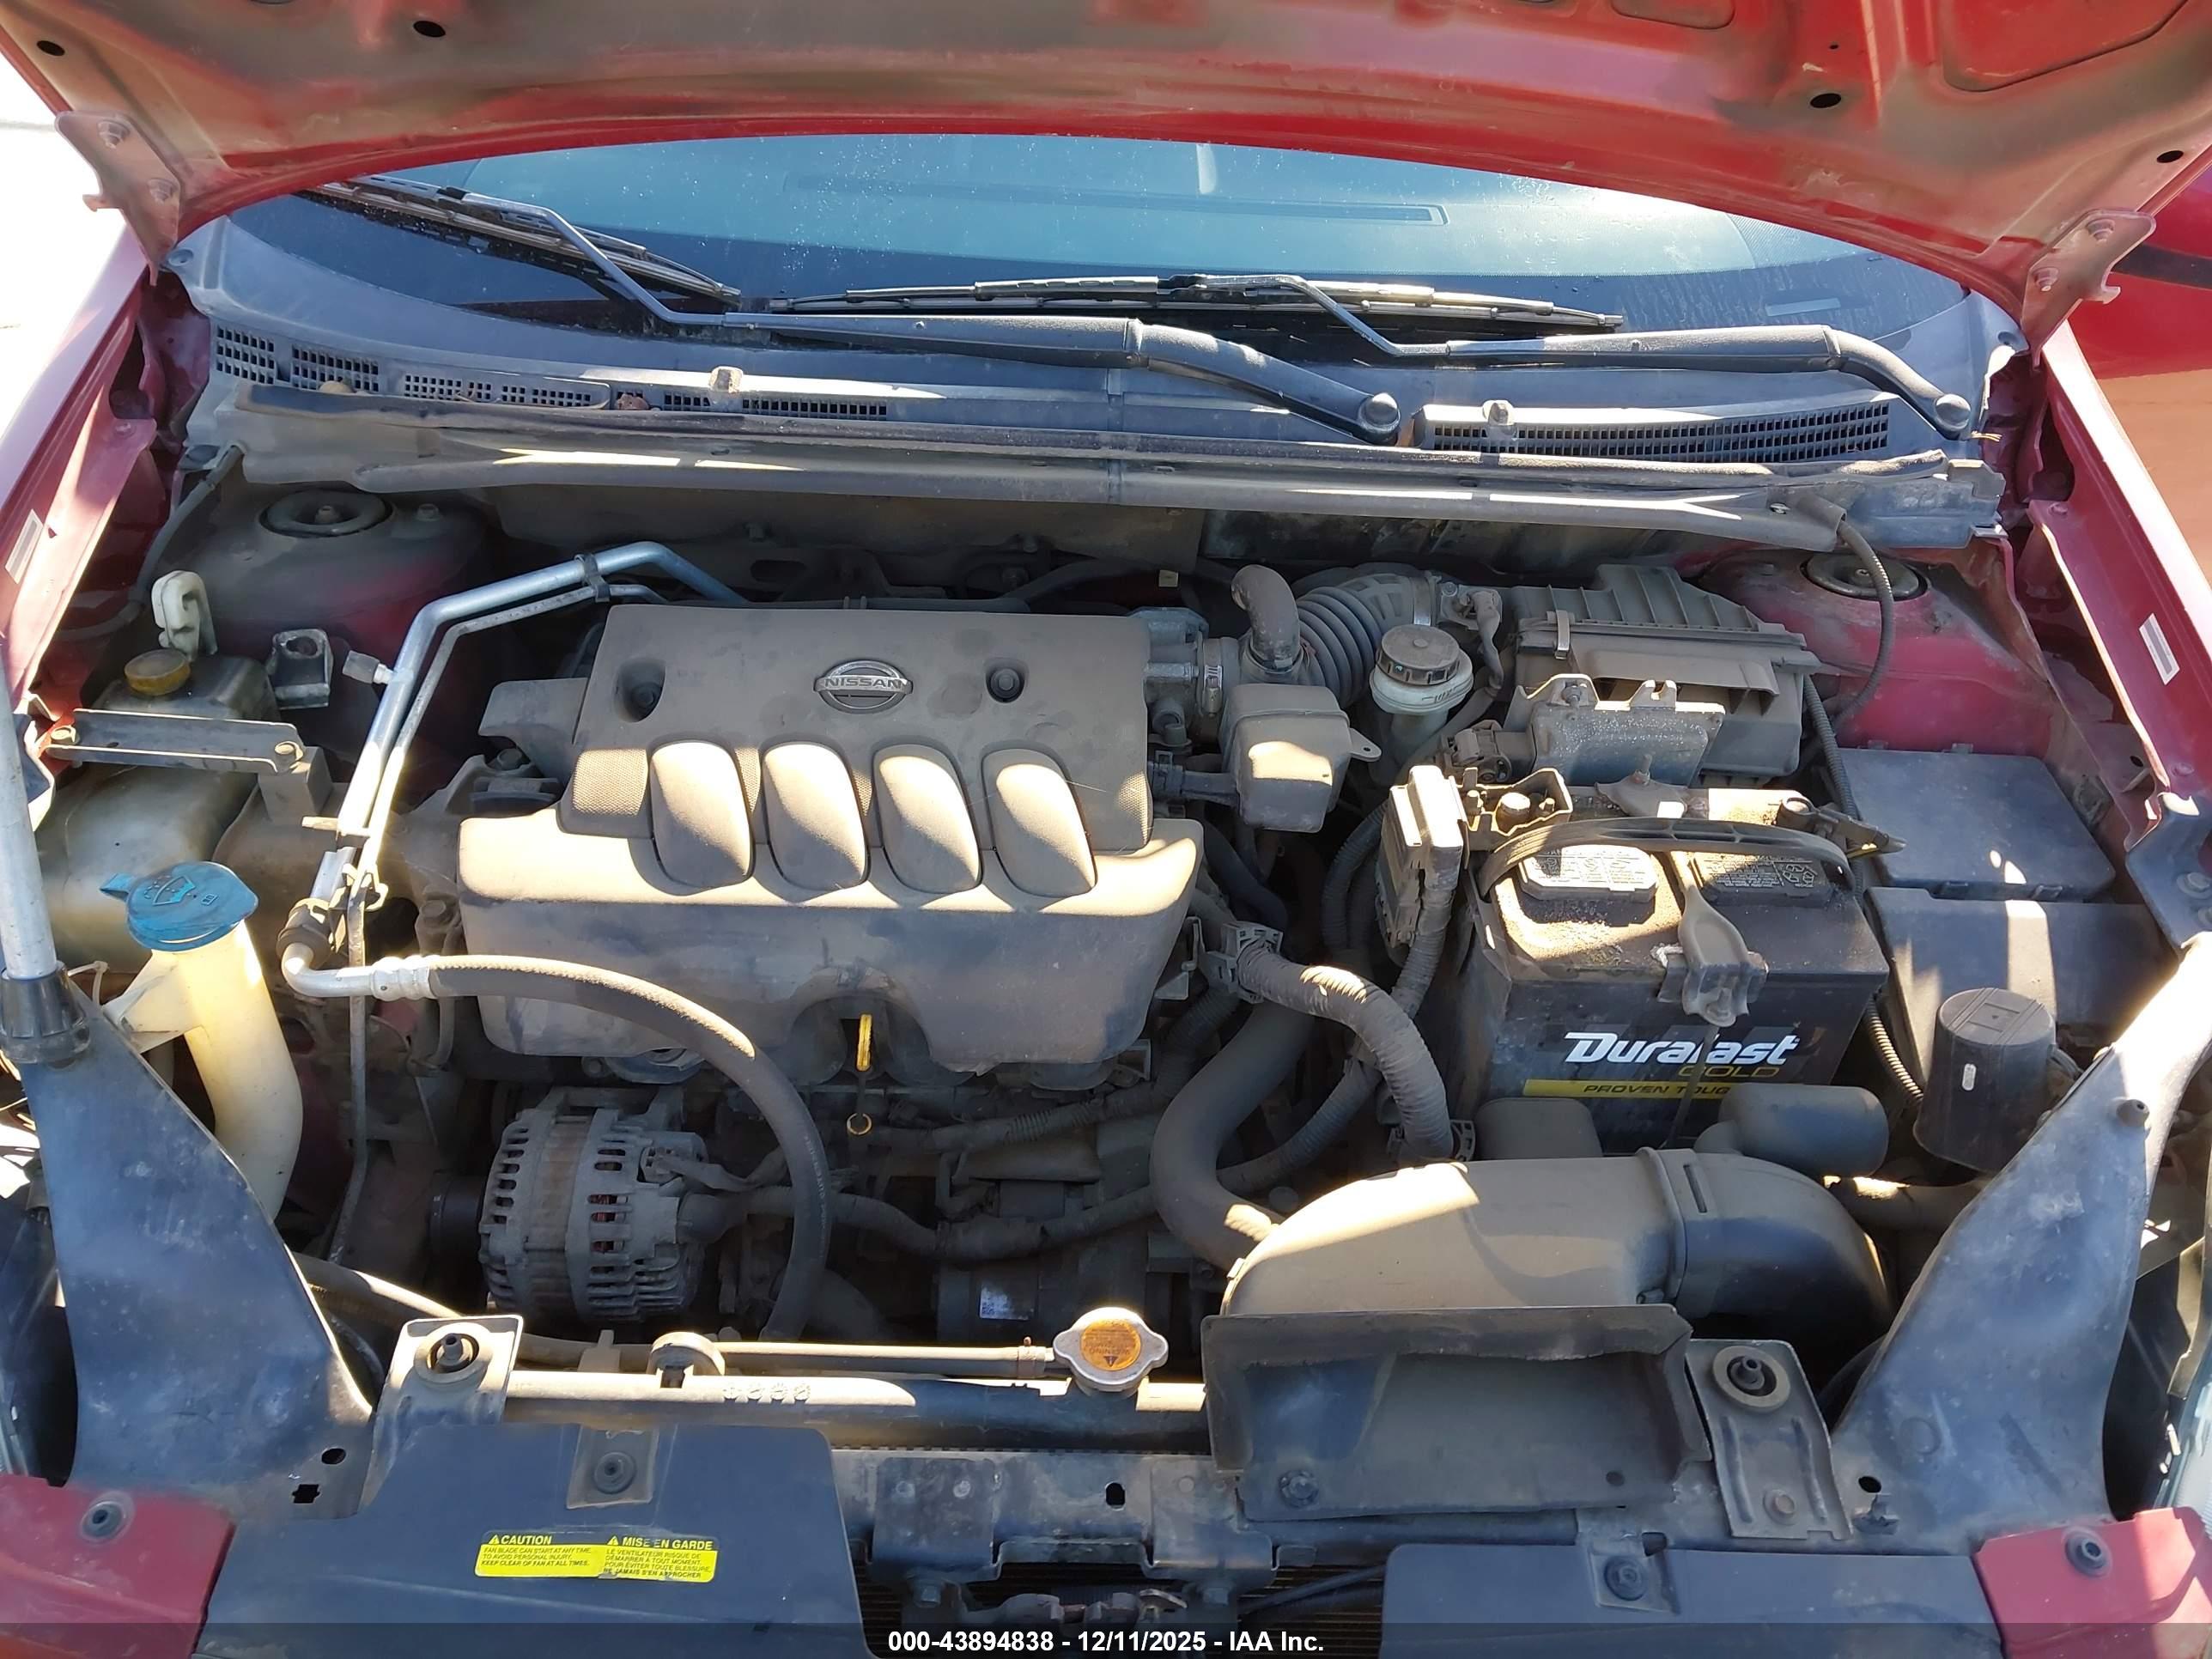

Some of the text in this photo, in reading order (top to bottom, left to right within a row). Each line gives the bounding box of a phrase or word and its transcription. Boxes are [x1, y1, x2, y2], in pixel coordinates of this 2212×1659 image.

[824, 678, 904, 690] NISSAN
[1583, 1085, 1670, 1095] PROVEN
[501, 1534, 552, 1545] CAUTION
[622, 1536, 714, 1550] MISE EN GARDE
[617, 1549, 663, 1558] VENTILATEUR
